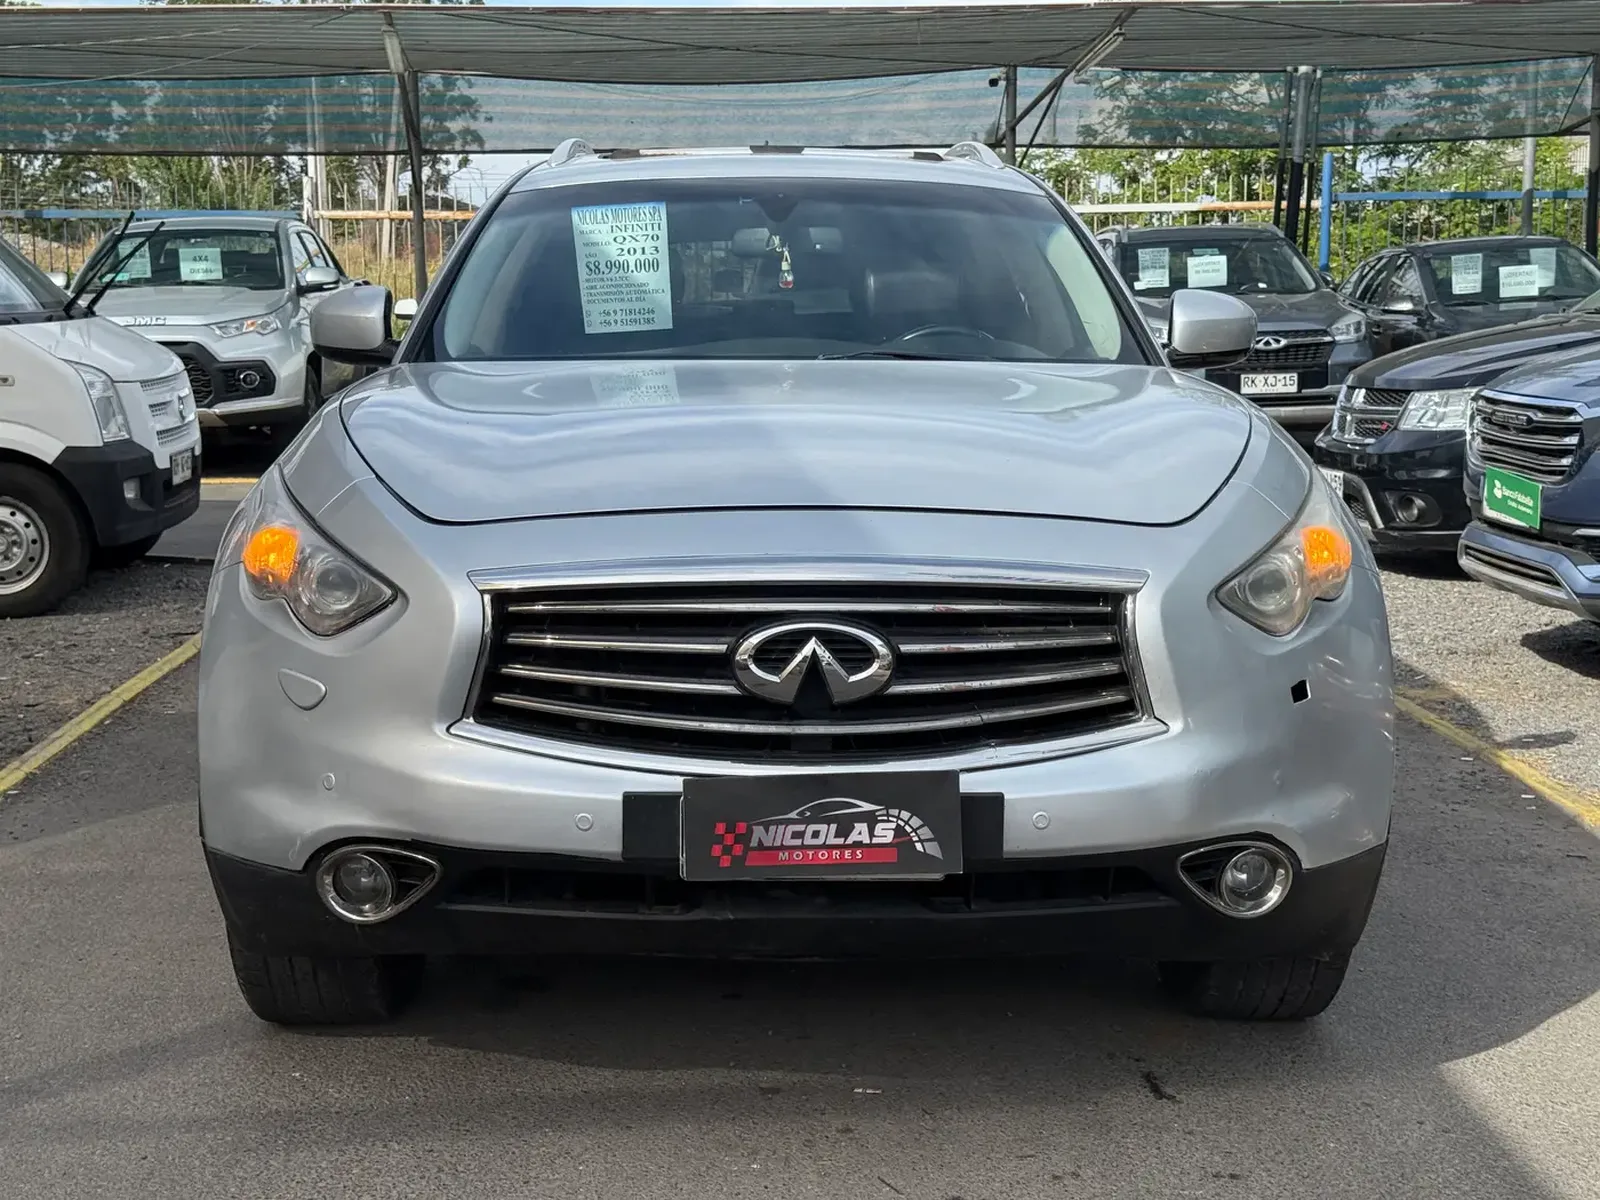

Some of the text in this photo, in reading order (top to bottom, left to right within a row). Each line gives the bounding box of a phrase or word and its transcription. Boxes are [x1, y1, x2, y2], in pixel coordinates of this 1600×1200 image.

[577, 208, 609, 226] NICOLAS
[610, 207, 647, 224] MOTORES
[610, 222, 662, 234] INFINITI
[613, 234, 660, 245] QX70
[616, 246, 660, 257] 2013
[585, 257, 660, 277] $8.990.000
[598, 307, 656, 317] +56 9 71814246
[599, 317, 656, 327] +56 9 51591385
[750, 823, 898, 847] NICOLAS
[779, 850, 864, 861] MOTORES
